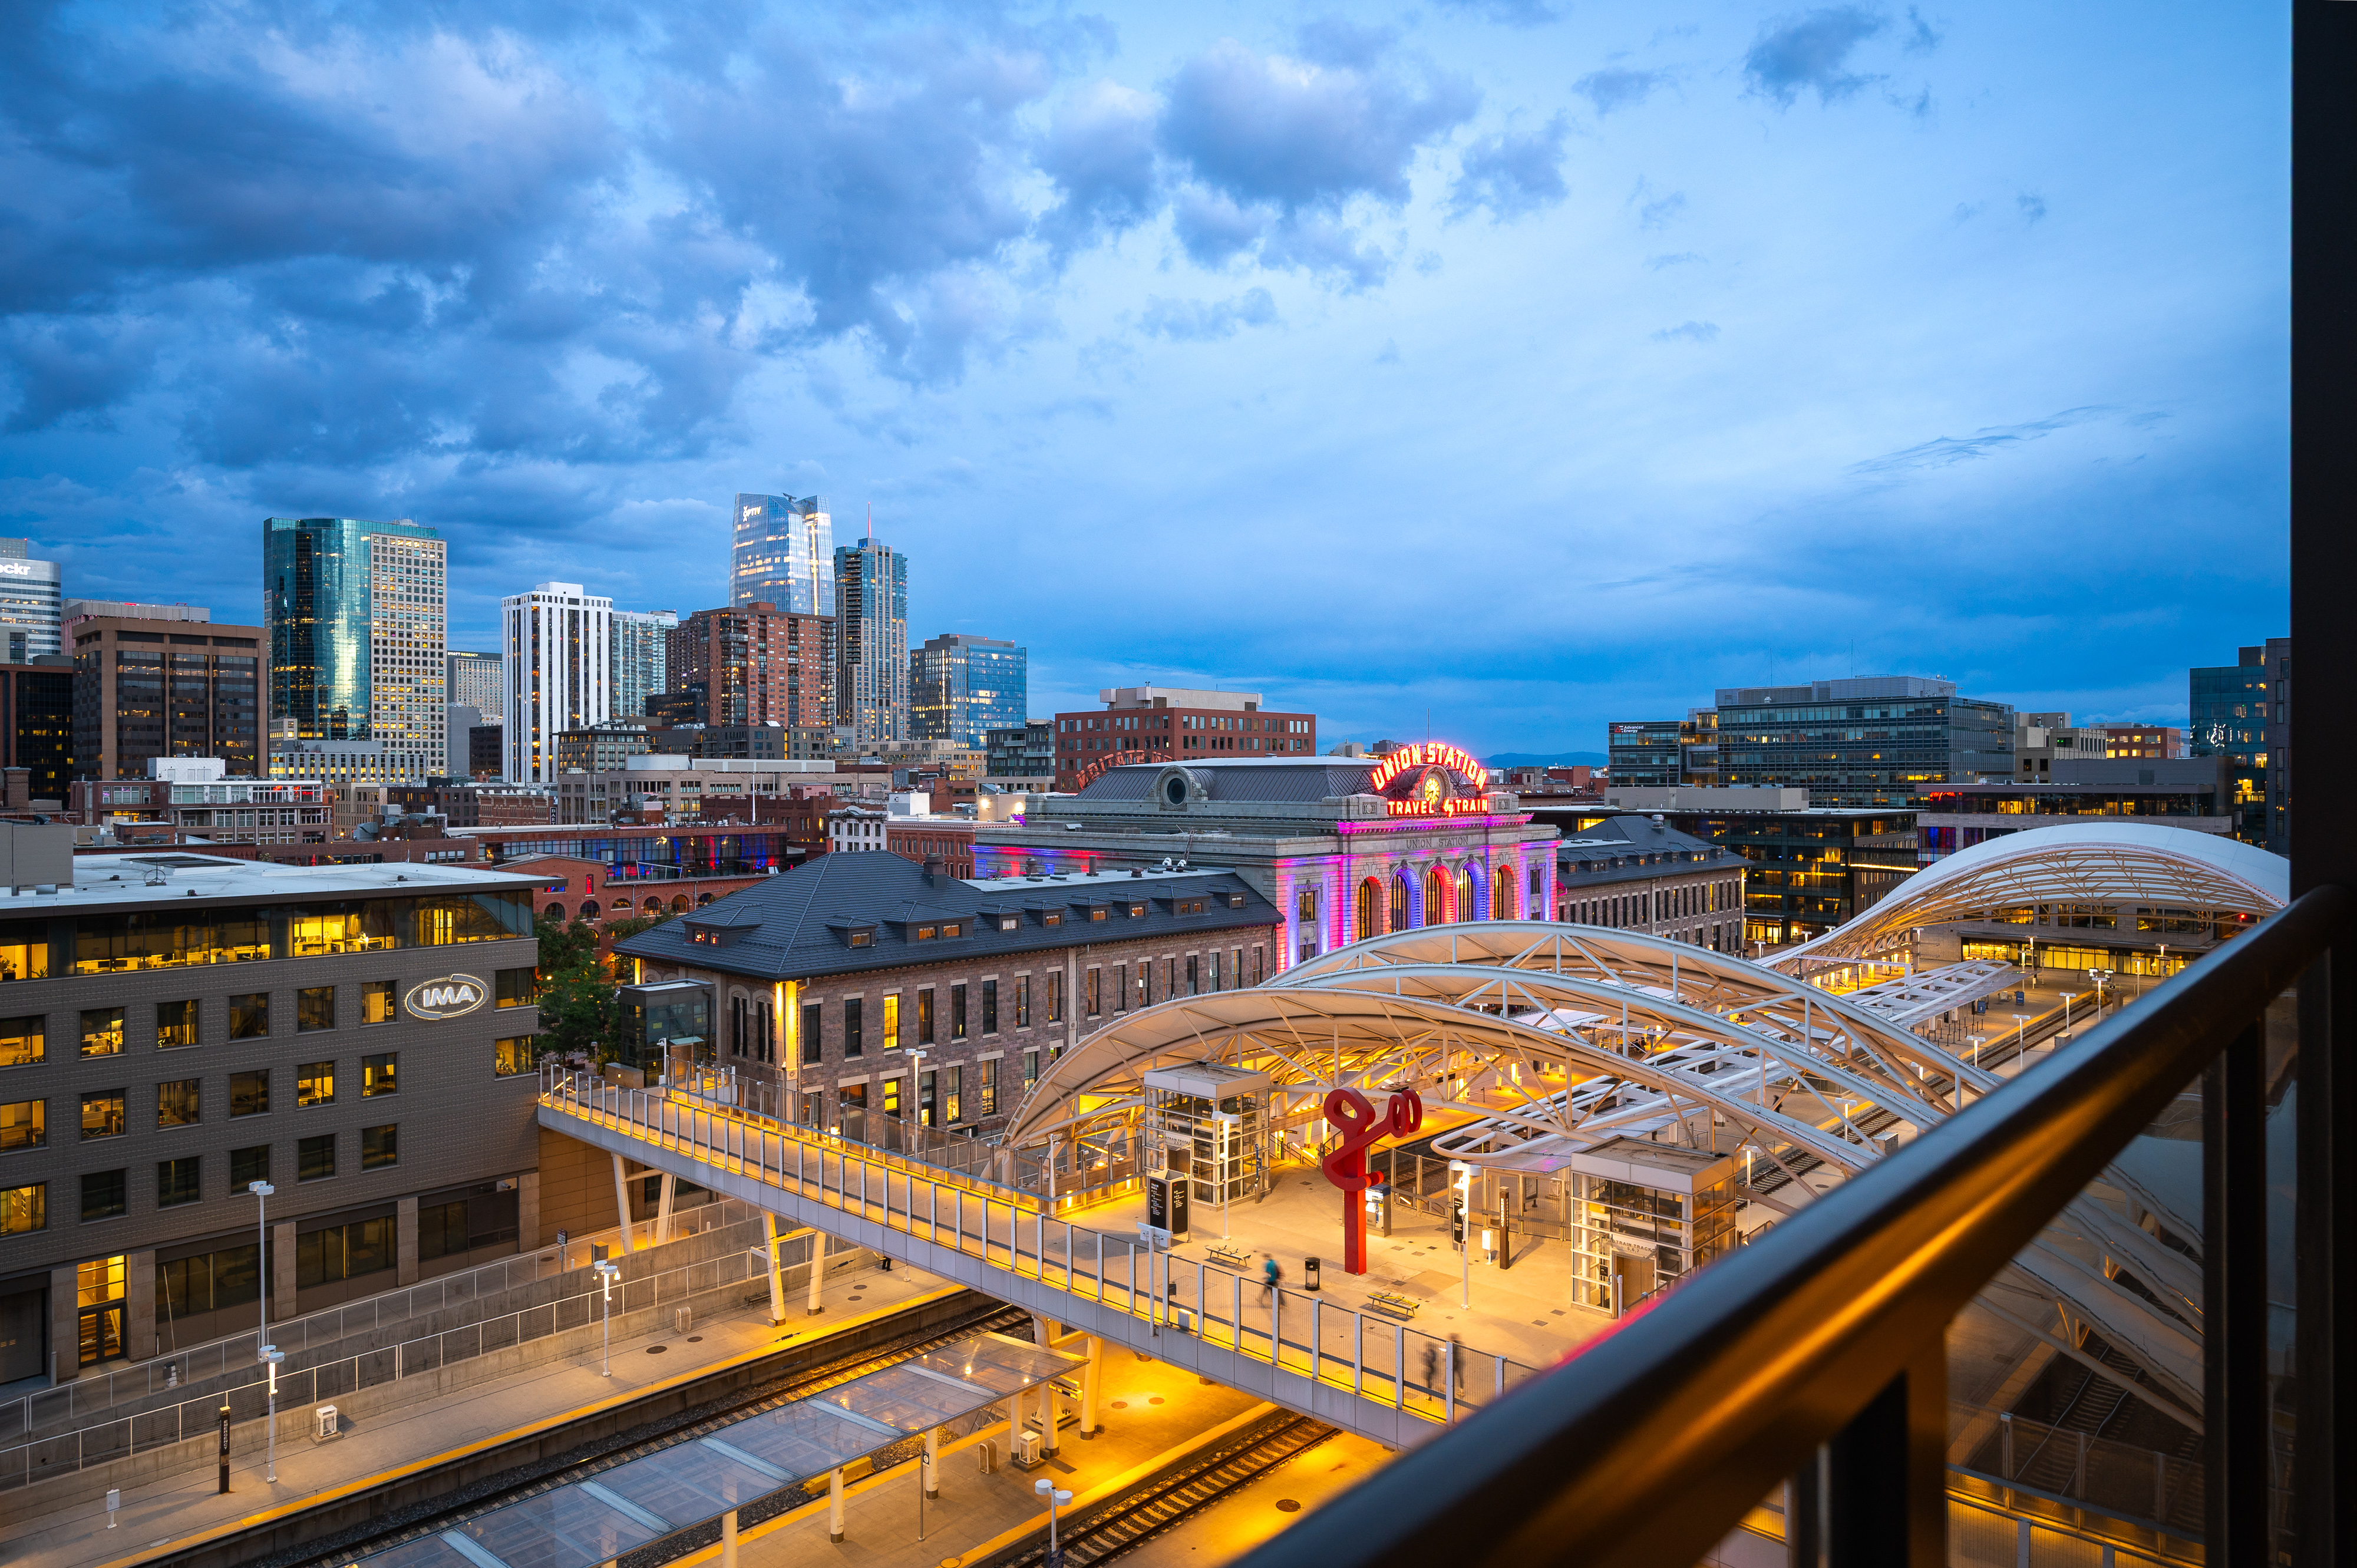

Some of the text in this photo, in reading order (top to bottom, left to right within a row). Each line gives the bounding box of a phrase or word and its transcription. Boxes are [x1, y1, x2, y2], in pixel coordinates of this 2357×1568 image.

[1371, 742, 1487, 791] UNION STATION
[1387, 798, 1488, 818] TRAVEL by TRAIN
[1406, 836, 1468, 849] UNION STATION
[423, 985, 476, 1007] IMA
